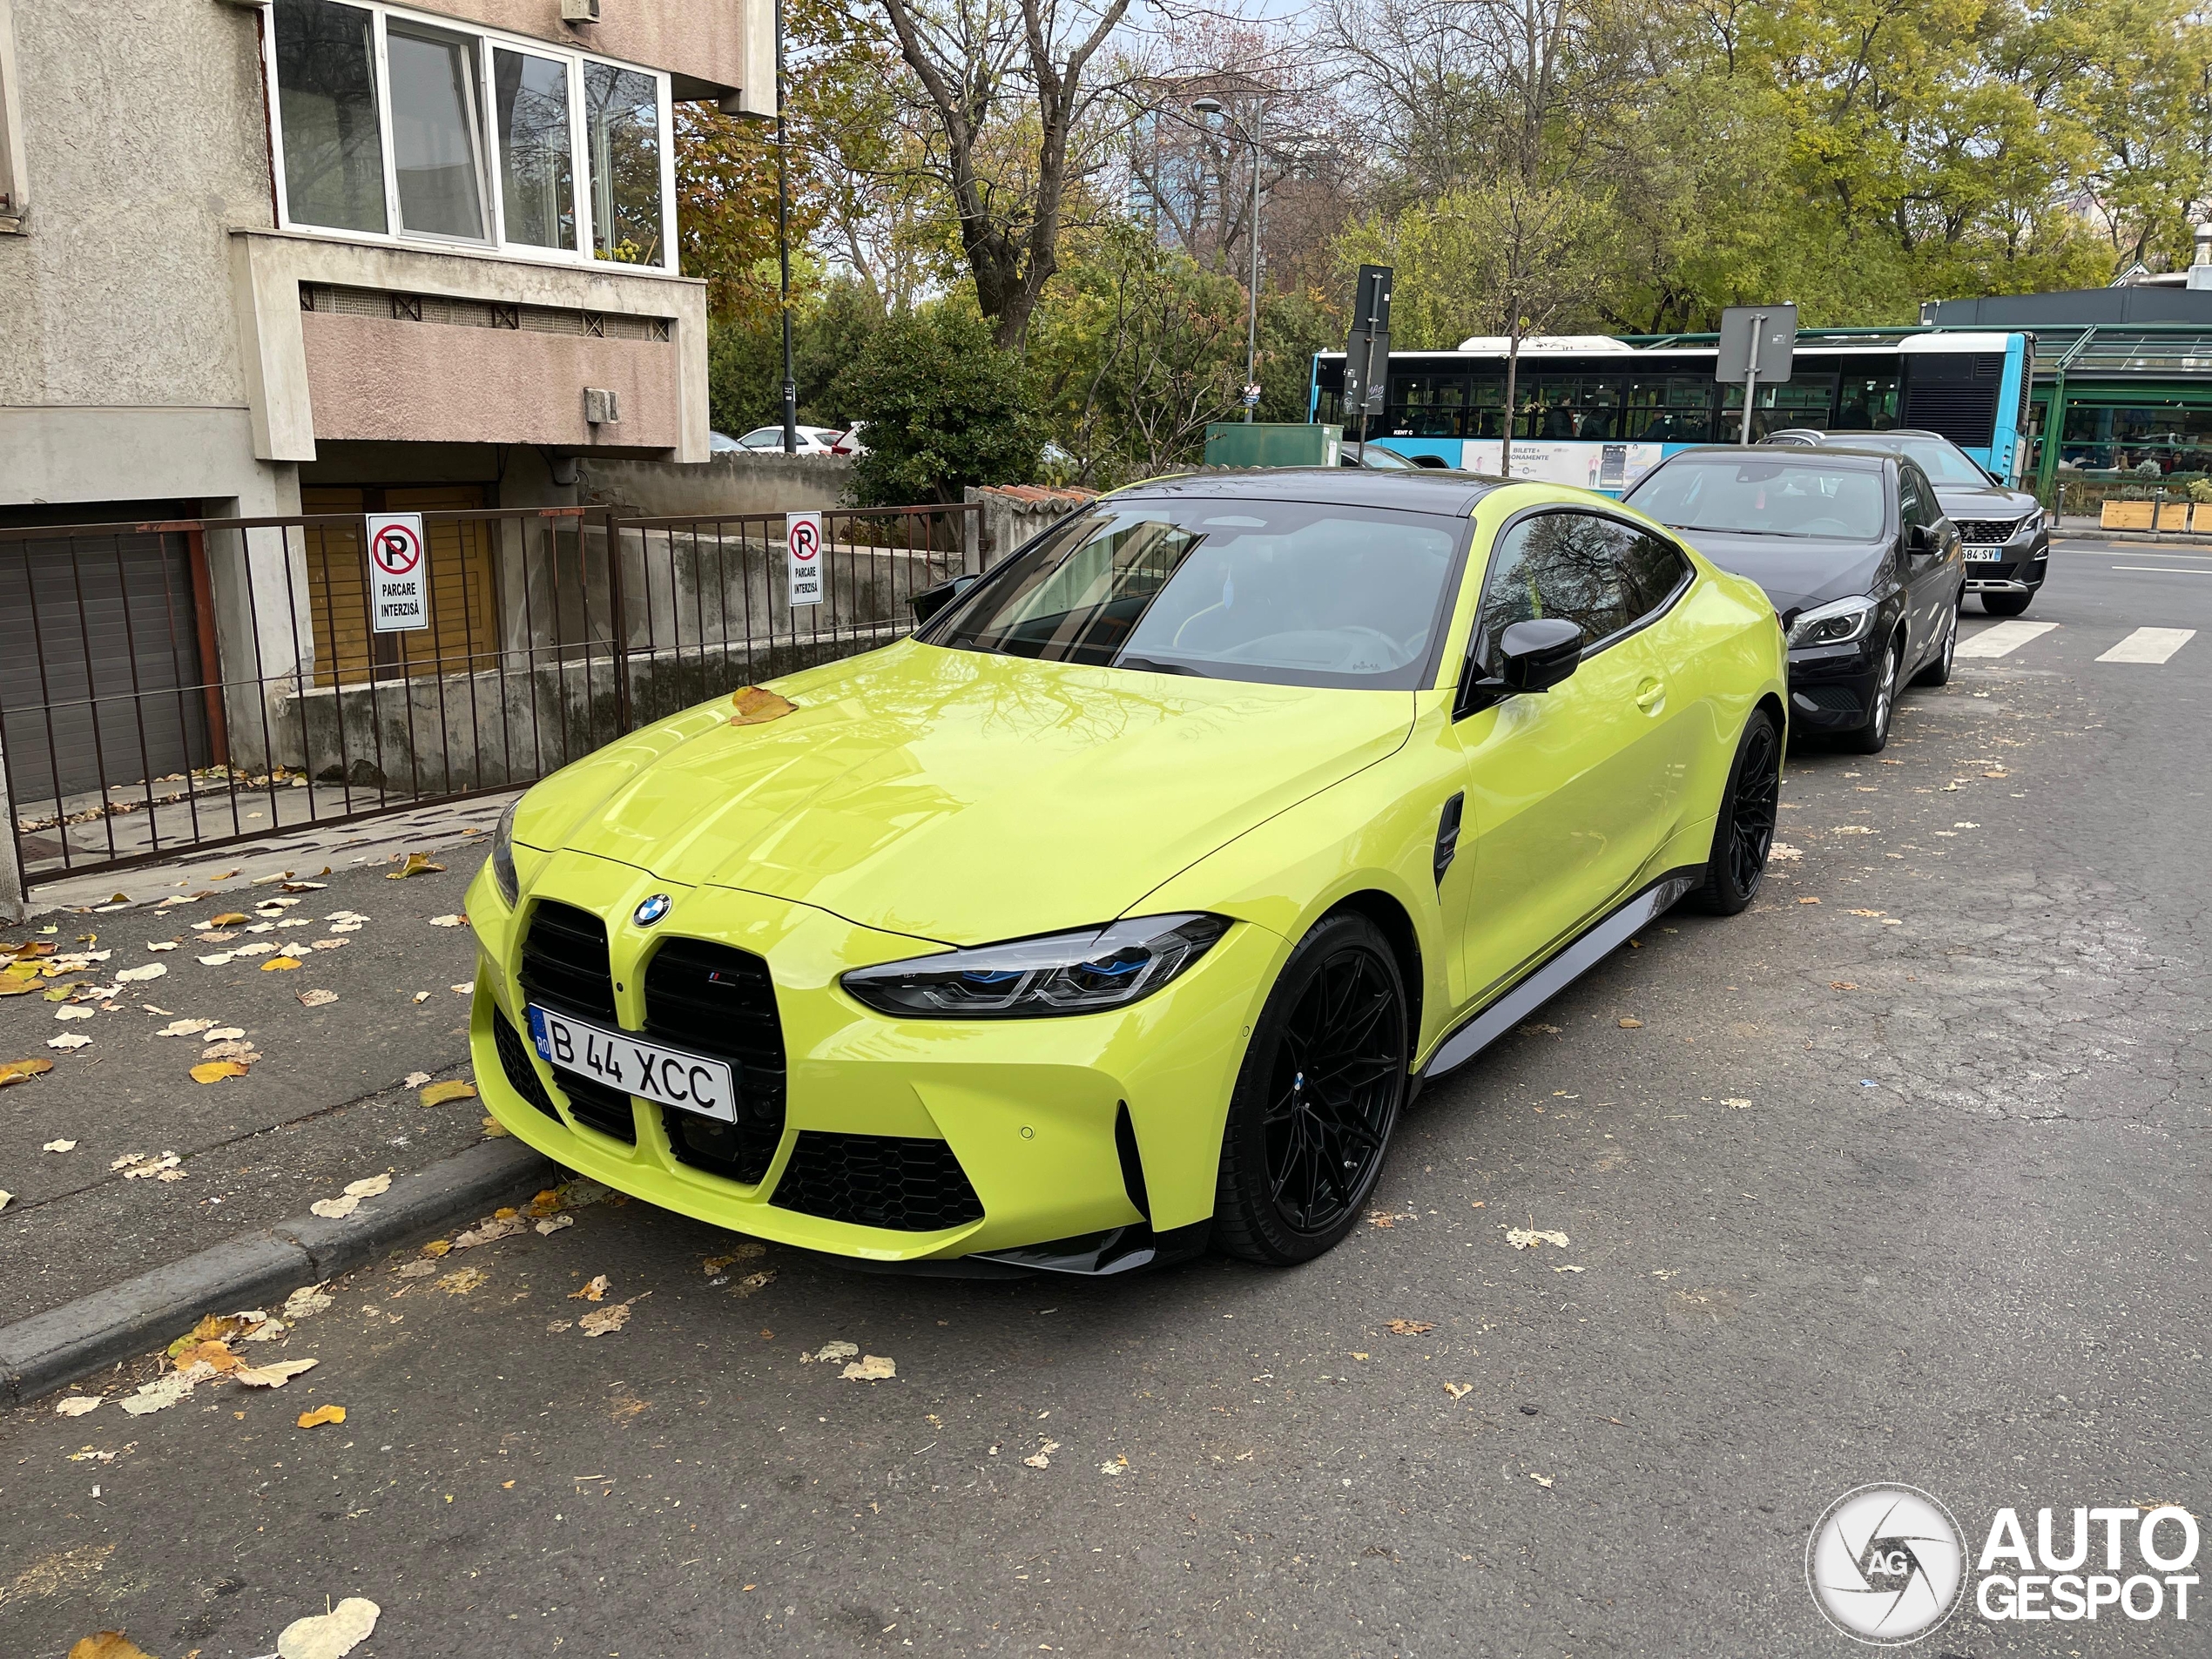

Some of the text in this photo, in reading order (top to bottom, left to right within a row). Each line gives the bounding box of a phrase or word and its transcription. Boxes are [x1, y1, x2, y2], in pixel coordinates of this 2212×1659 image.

[794, 566, 816, 578] PARCARE
[381, 582, 416, 597] PARCARE
[793, 580, 819, 594] INTERZISĂ
[381, 599, 420, 617] INTERZISĂ
[536, 1035, 550, 1055] RO
[550, 1019, 716, 1109] B 44 XCC
